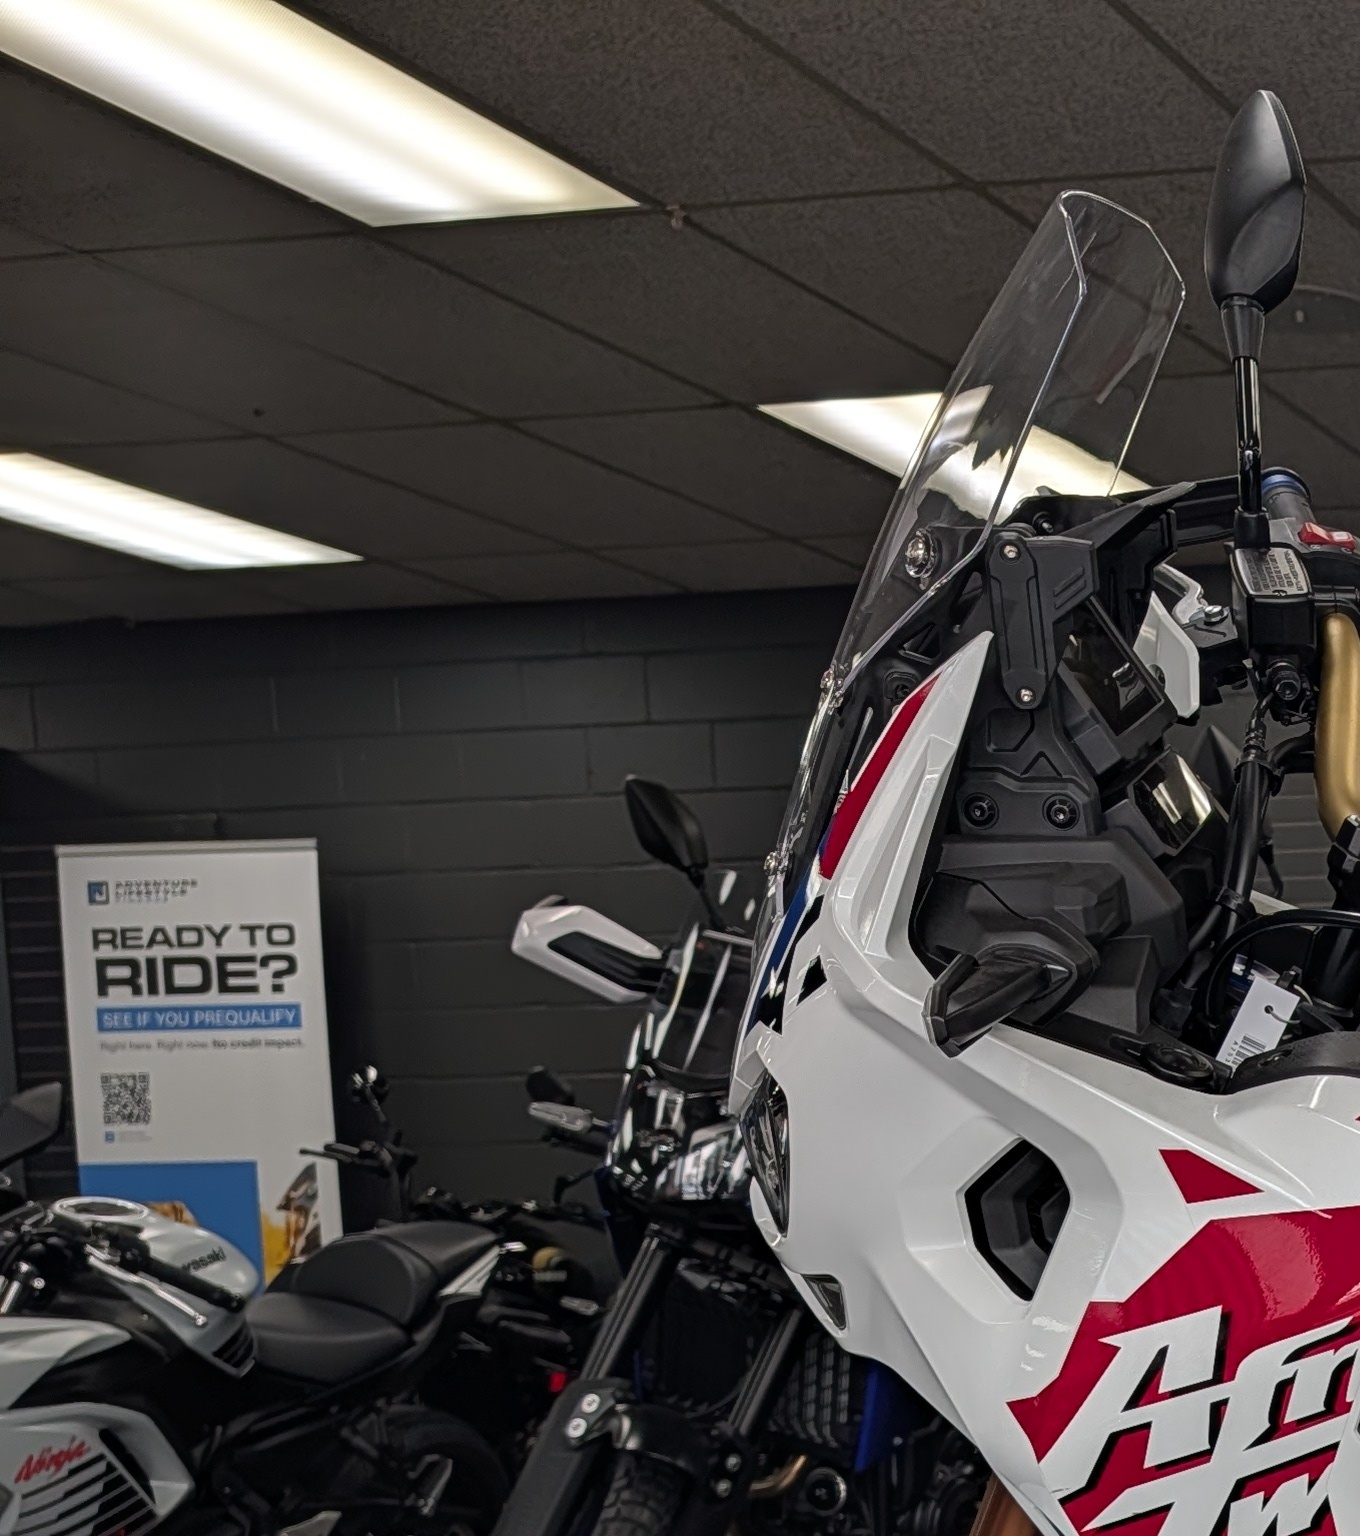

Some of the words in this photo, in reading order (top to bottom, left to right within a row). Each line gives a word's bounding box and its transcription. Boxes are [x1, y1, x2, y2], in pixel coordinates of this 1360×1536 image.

[92, 924, 231, 951] READY
[239, 923, 296, 948] TO
[96, 953, 298, 998] RIDE?
[103, 1011, 132, 1028] SEE
[137, 1011, 148, 1027] IF
[155, 1010, 189, 1027] YOU
[194, 1008, 296, 1026] PREQUALIFY
[14, 1434, 91, 1484] Ninja
